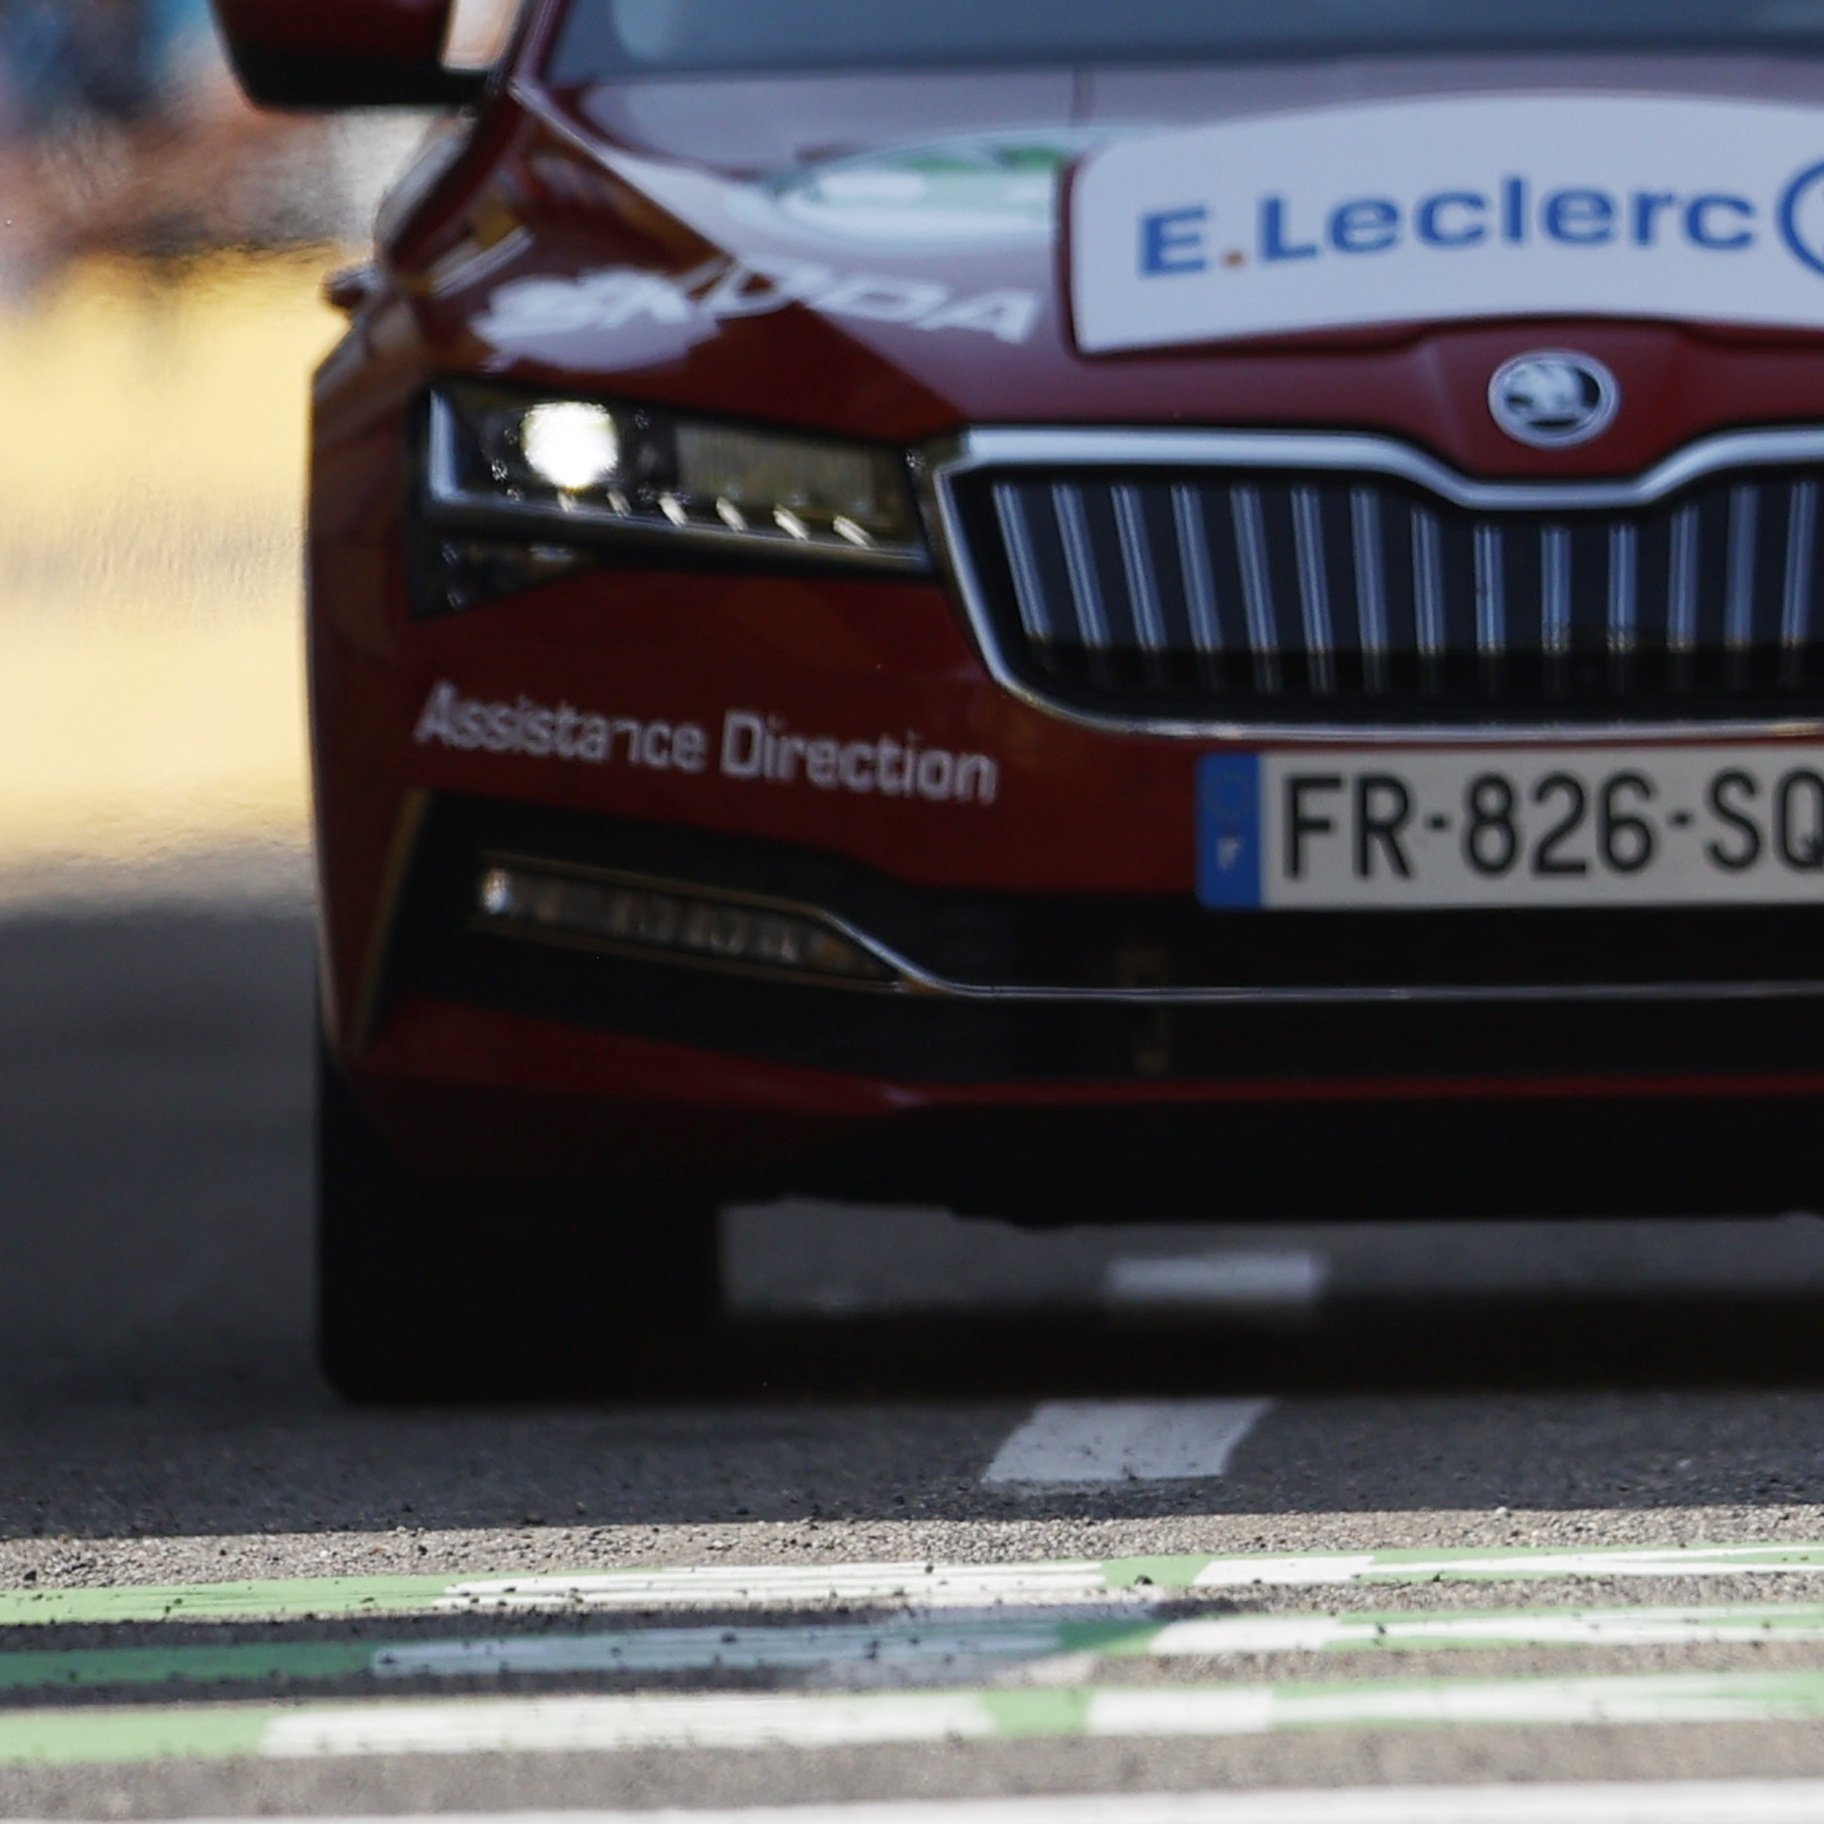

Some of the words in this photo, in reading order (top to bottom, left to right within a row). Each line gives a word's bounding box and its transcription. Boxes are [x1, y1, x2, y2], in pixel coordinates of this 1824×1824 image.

[1137, 173, 1758, 279] E.Leclerc
[412, 679, 708, 771] Assistance
[719, 708, 998, 806] Direction
